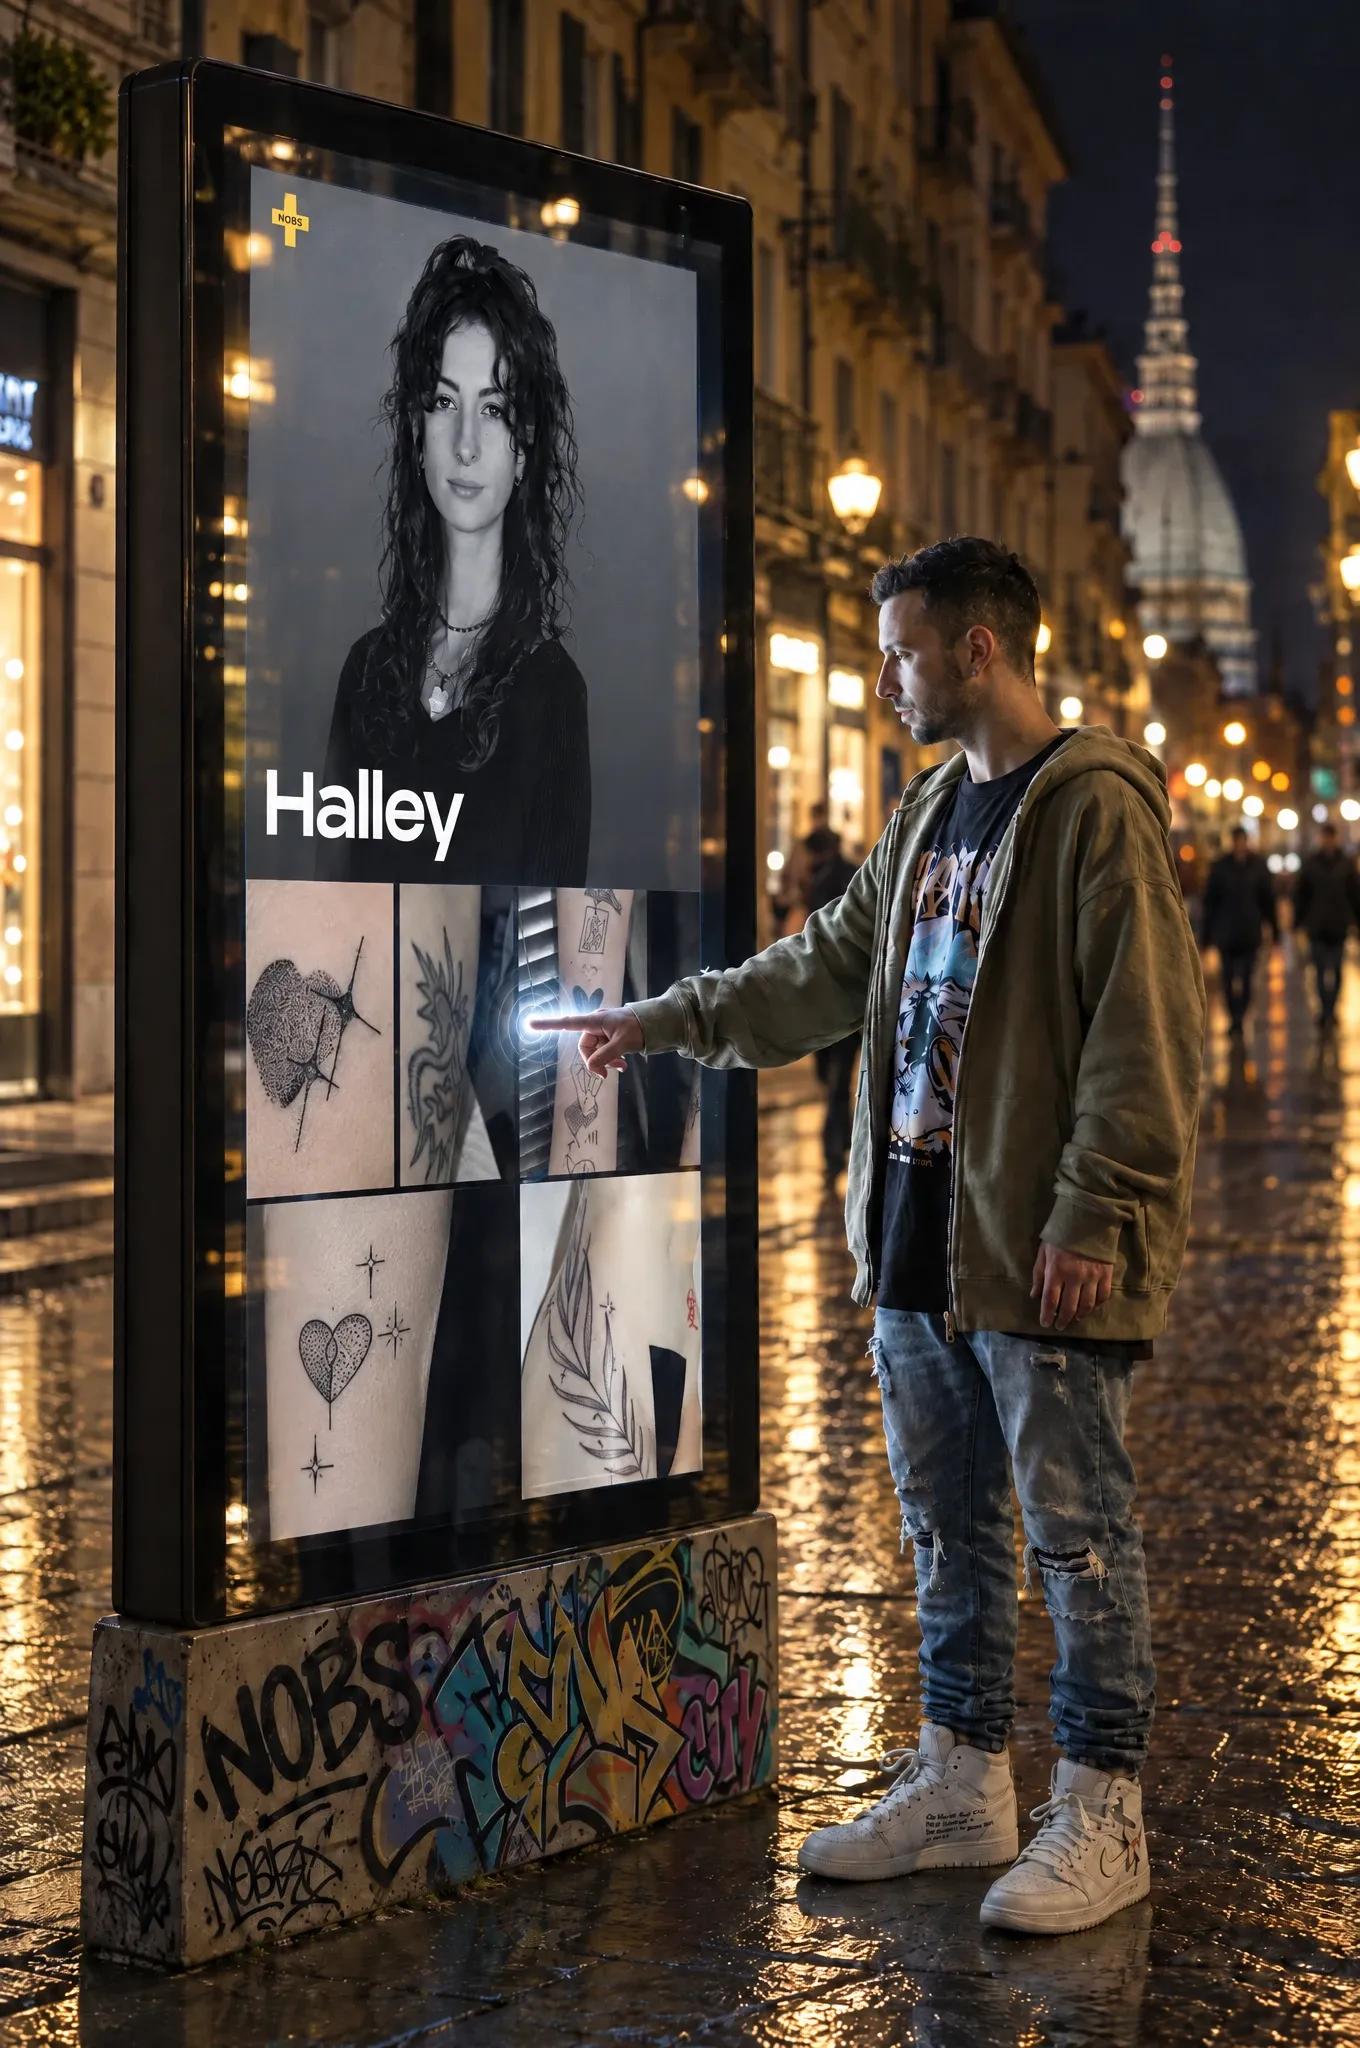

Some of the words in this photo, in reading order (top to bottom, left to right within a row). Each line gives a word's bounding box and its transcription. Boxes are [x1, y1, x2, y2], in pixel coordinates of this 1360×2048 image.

[278, 213, 303, 227] NOBS
[266, 768, 465, 862] Halley
[201, 1620, 422, 1822] NOBS
